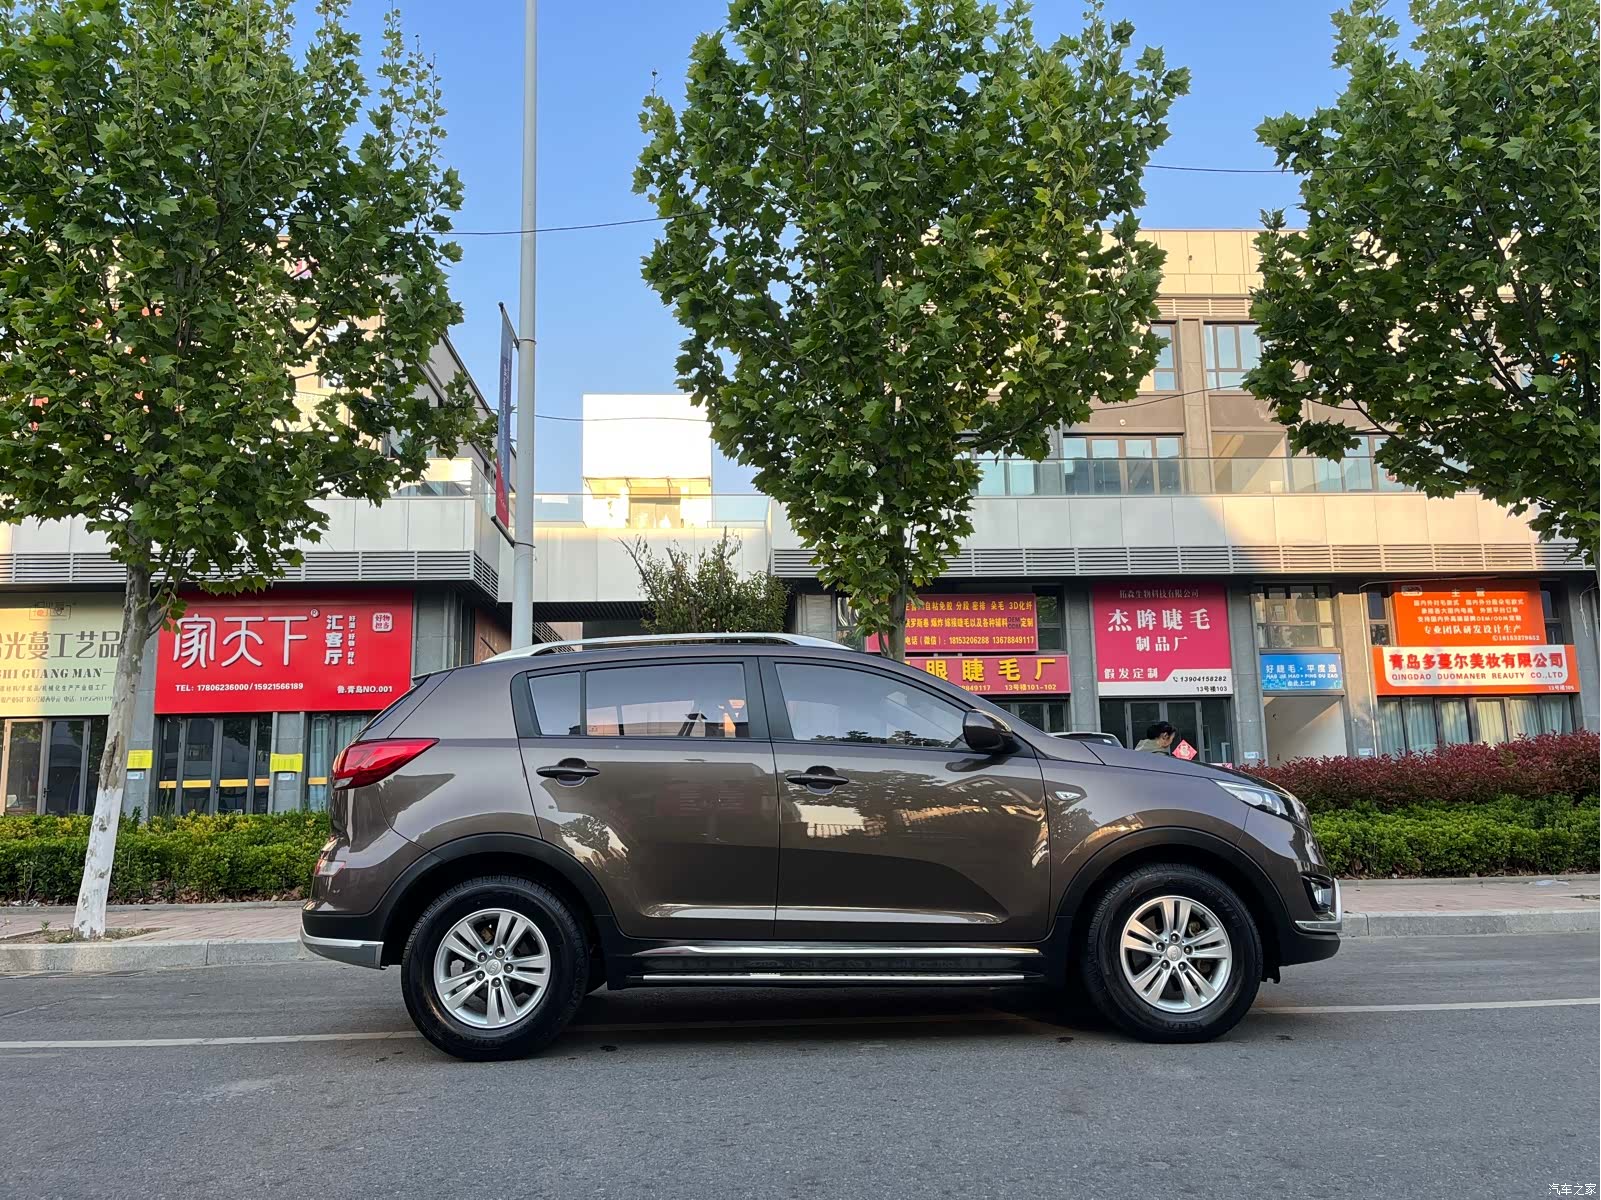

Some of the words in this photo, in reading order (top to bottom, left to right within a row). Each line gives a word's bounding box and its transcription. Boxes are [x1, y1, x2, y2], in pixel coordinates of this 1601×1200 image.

[1107, 608, 1211, 632] 杰眸睫毛
[172, 613, 308, 669] 家天下
[324, 614, 344, 665] 汇客厅
[1135, 636, 1188, 651] 制品厂
[905, 657, 1056, 682] 眼睫毛厂
[1389, 653, 1563, 670] 青岛多蔓尔美妆有限公司
[0, 669, 17, 679] HI
[22, 669, 69, 679] GUANG
[72, 668, 102, 679] MAN
[1104, 667, 1159, 679] 假发定制
[1391, 672, 1432, 681] QINGDAO
[1437, 672, 1486, 680] DUOMANER
[1491, 671, 1525, 679] BEAUTY
[1004, 683, 1057, 691] 13号楼101-102
